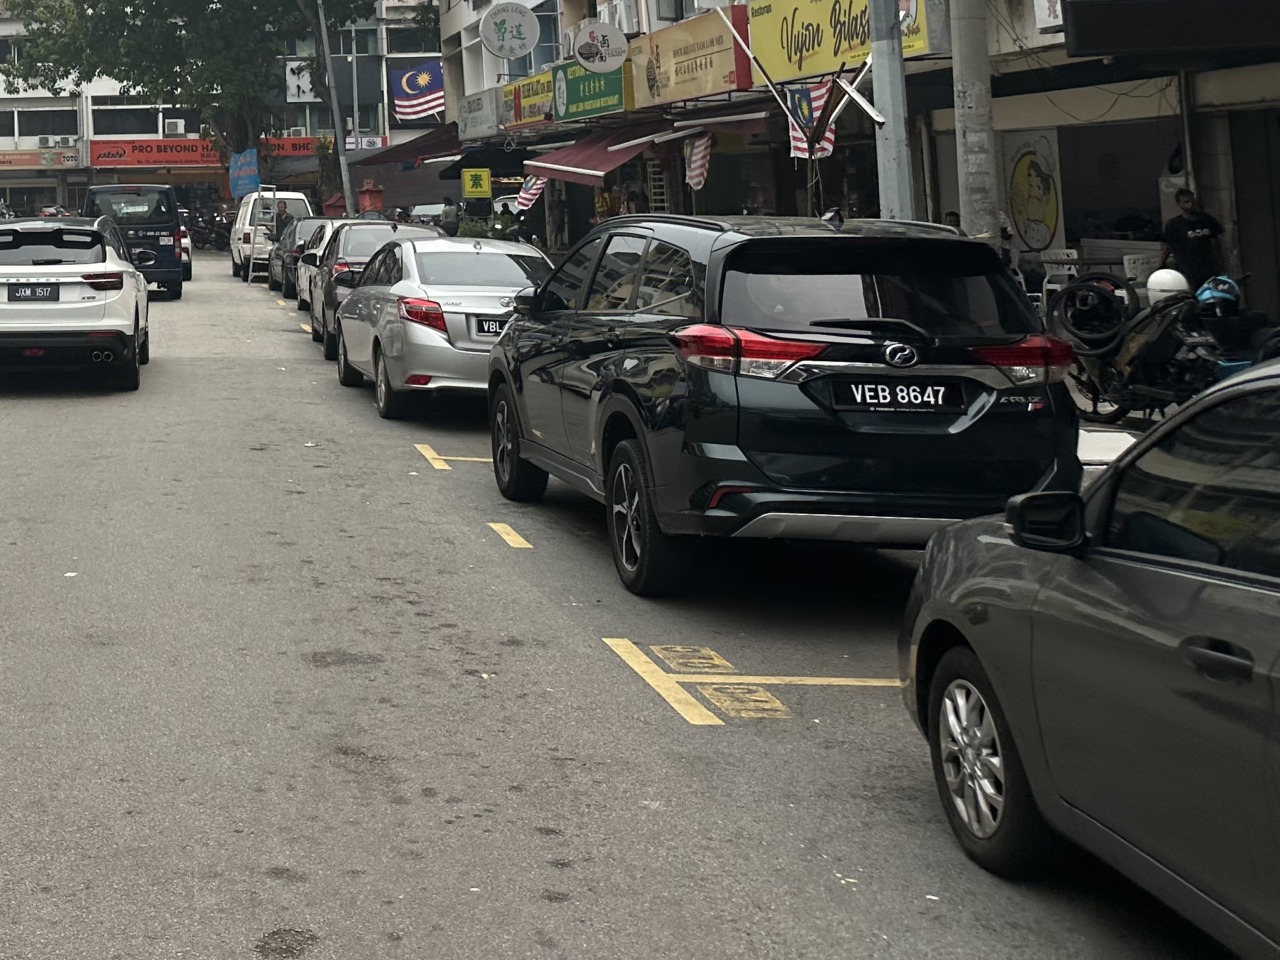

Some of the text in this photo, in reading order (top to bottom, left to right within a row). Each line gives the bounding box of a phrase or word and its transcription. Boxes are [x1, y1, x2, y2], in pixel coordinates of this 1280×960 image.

[751, 4, 772, 18] Restoran
[830, 0, 870, 57] Bilas
[132, 145, 153, 153] PRO
[157, 145, 198, 153] BEYOND
[469, 172, 483, 189] 素
[15, 287, 50, 296] JXM 1517
[483, 321, 502, 332] VBL
[851, 384, 945, 404] VEB 8647
